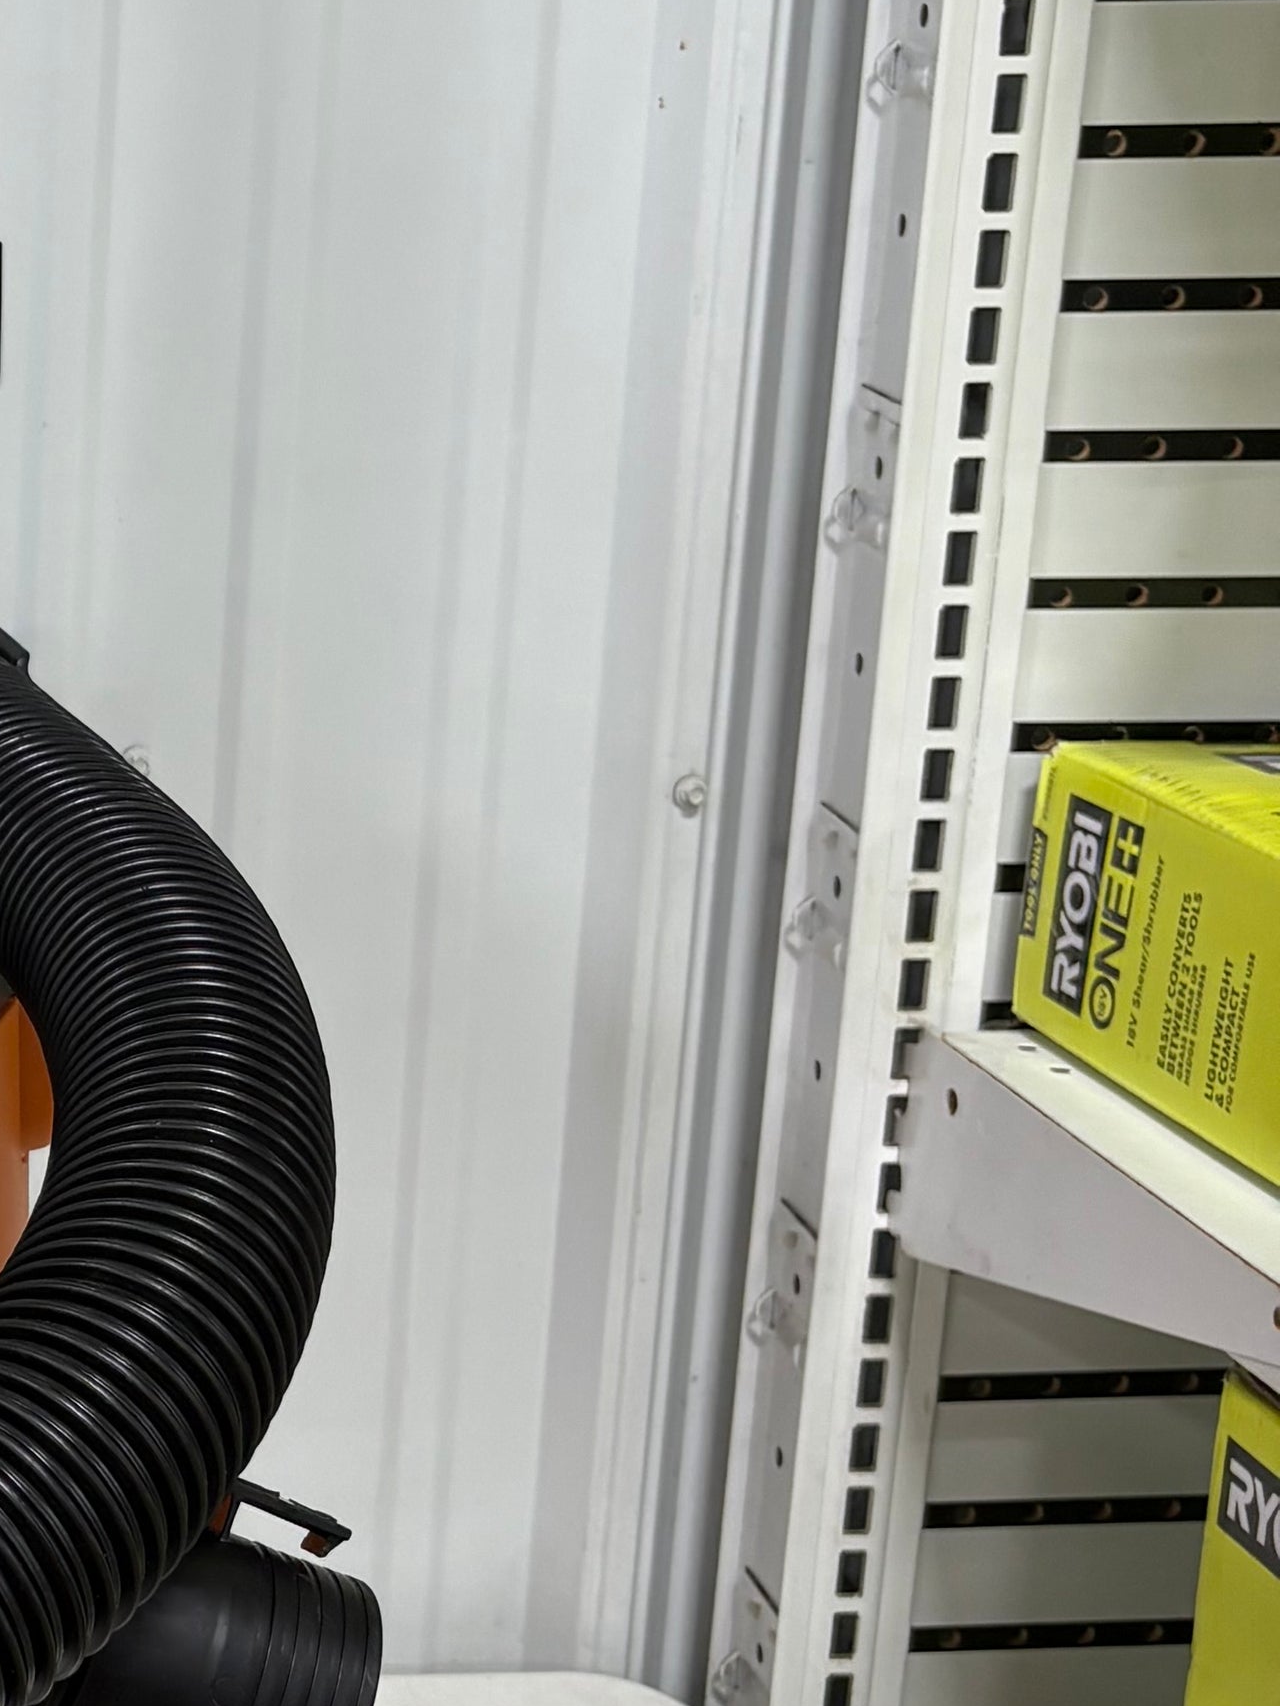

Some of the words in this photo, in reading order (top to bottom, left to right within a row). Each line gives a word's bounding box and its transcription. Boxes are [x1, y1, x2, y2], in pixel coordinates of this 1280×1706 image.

[1050, 811, 1104, 1000] RYOBI
[1156, 1003, 1173, 1070] EASILY
[1167, 892, 1192, 999] CONVERTS
[1165, 980, 1188, 1077] BETWEEN
[1184, 891, 1203, 957] TOOLS
[1126, 1010, 1138, 1049] 18V
[1203, 956, 1235, 1102] LIGHTWEIGHT
[1216, 986, 1241, 1086] COMPACT
